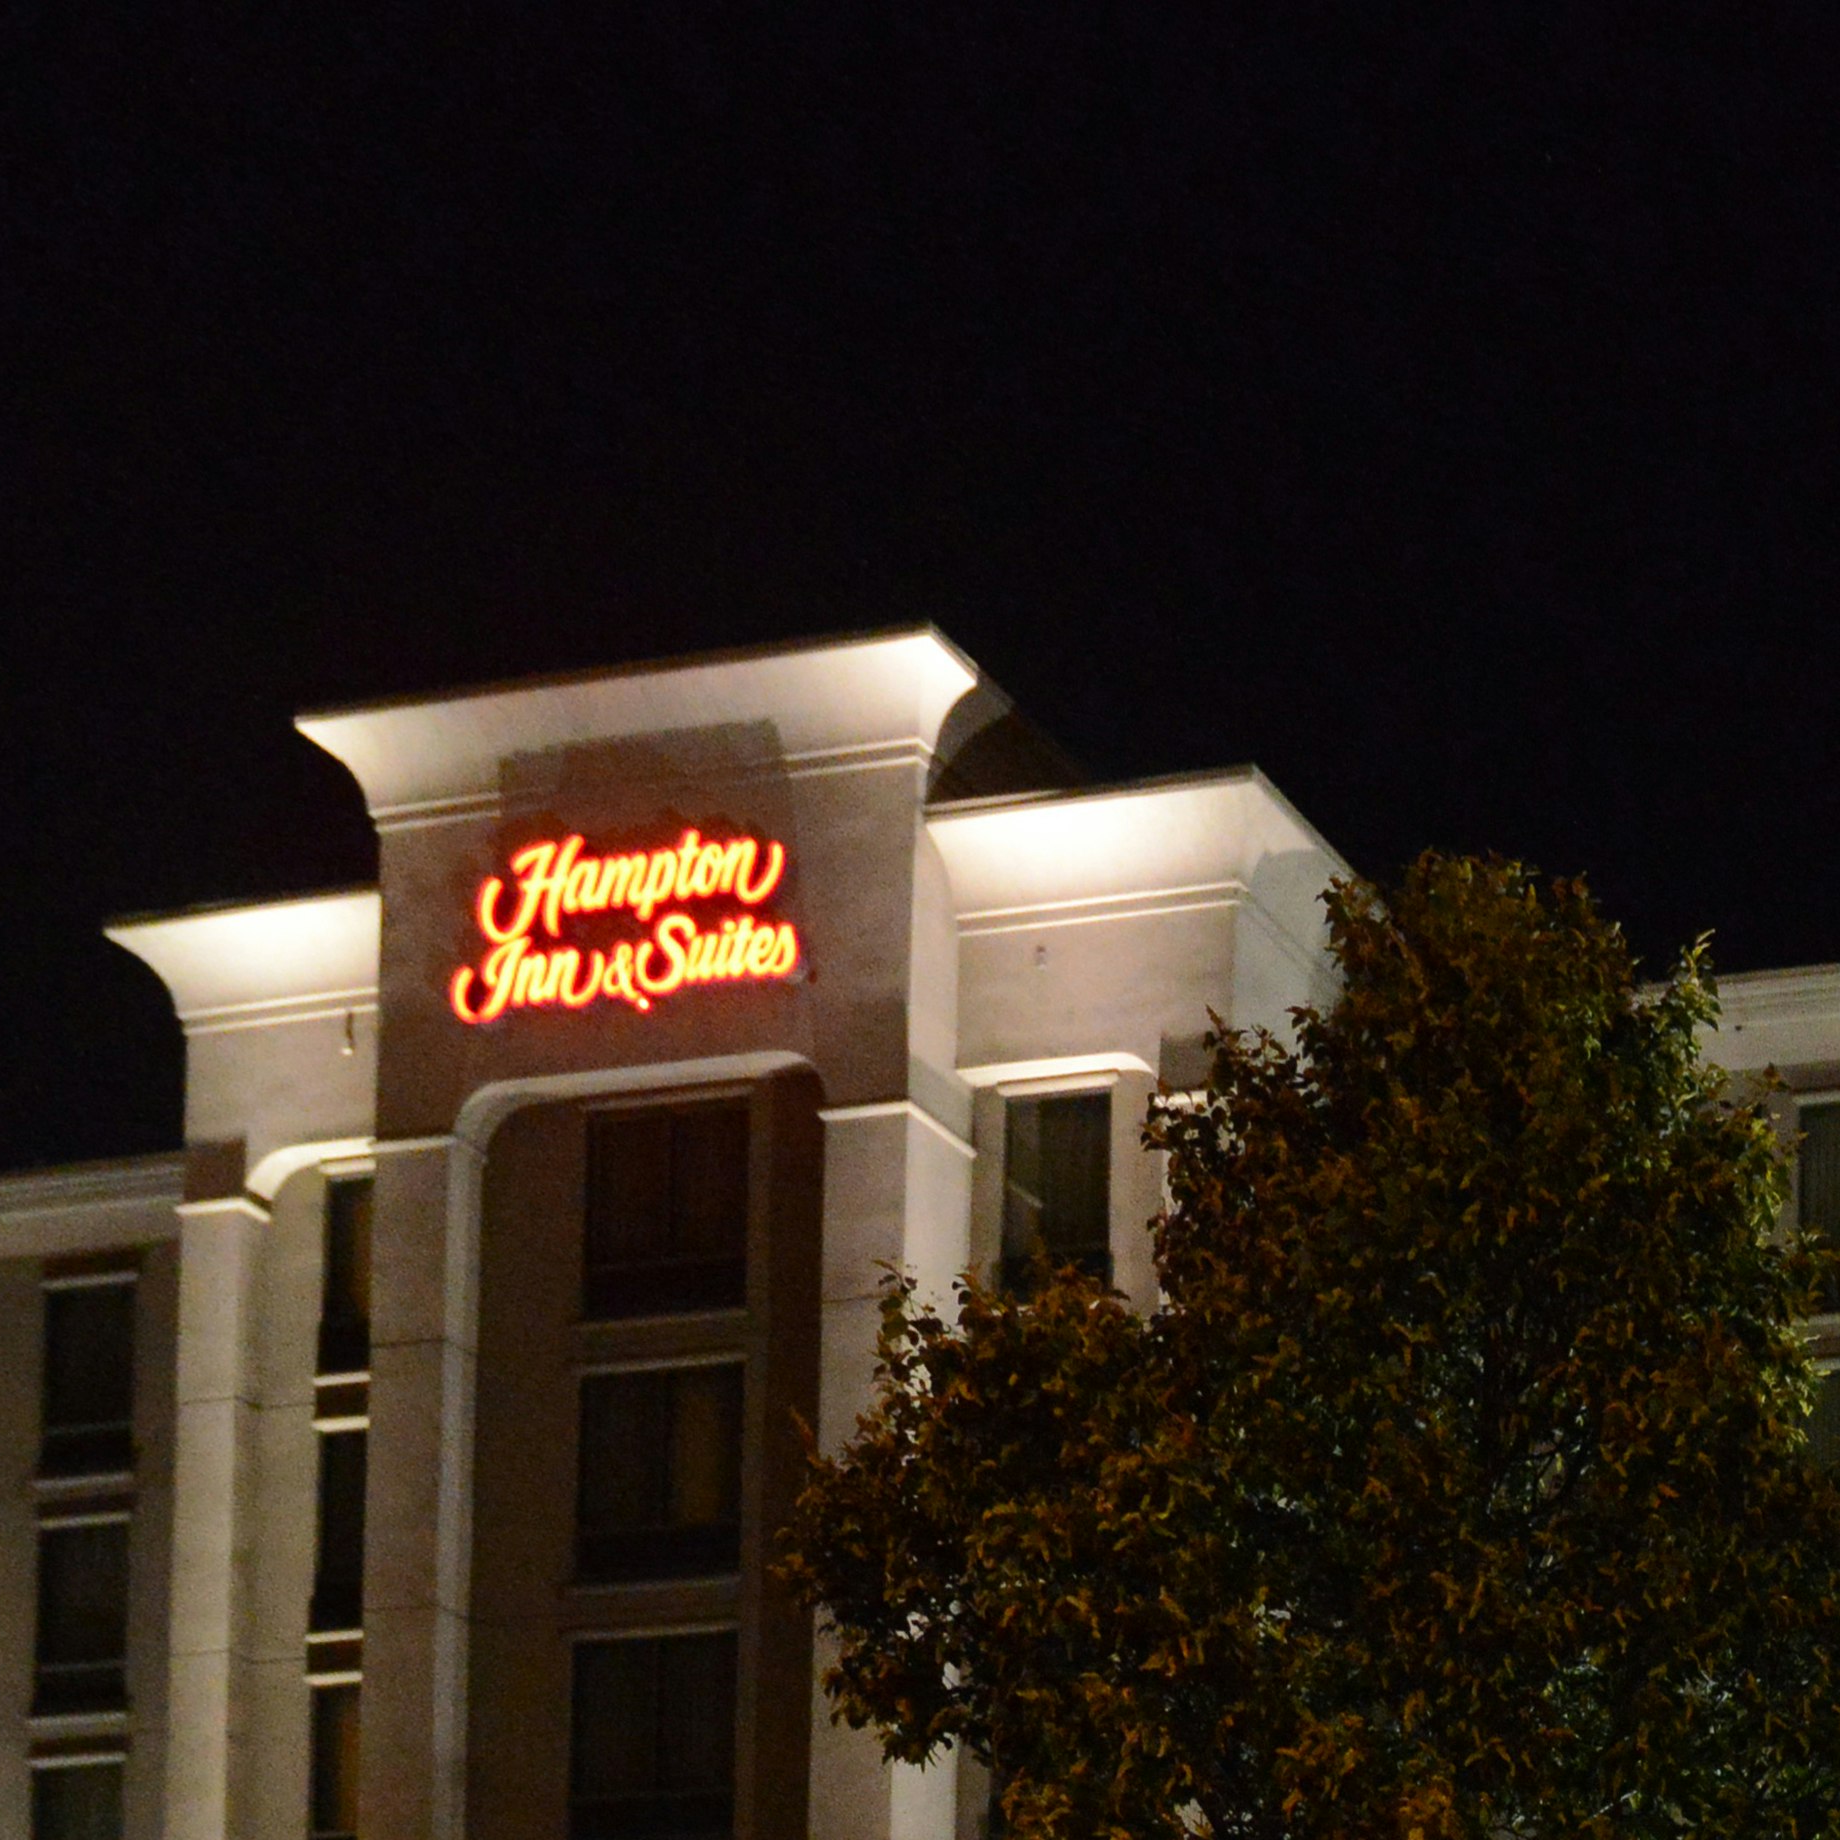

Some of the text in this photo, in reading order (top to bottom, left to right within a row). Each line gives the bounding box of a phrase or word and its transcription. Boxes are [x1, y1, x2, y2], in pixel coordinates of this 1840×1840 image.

[478, 829, 784, 942] Hampton
[451, 912, 799, 1023] Inn & Suites
